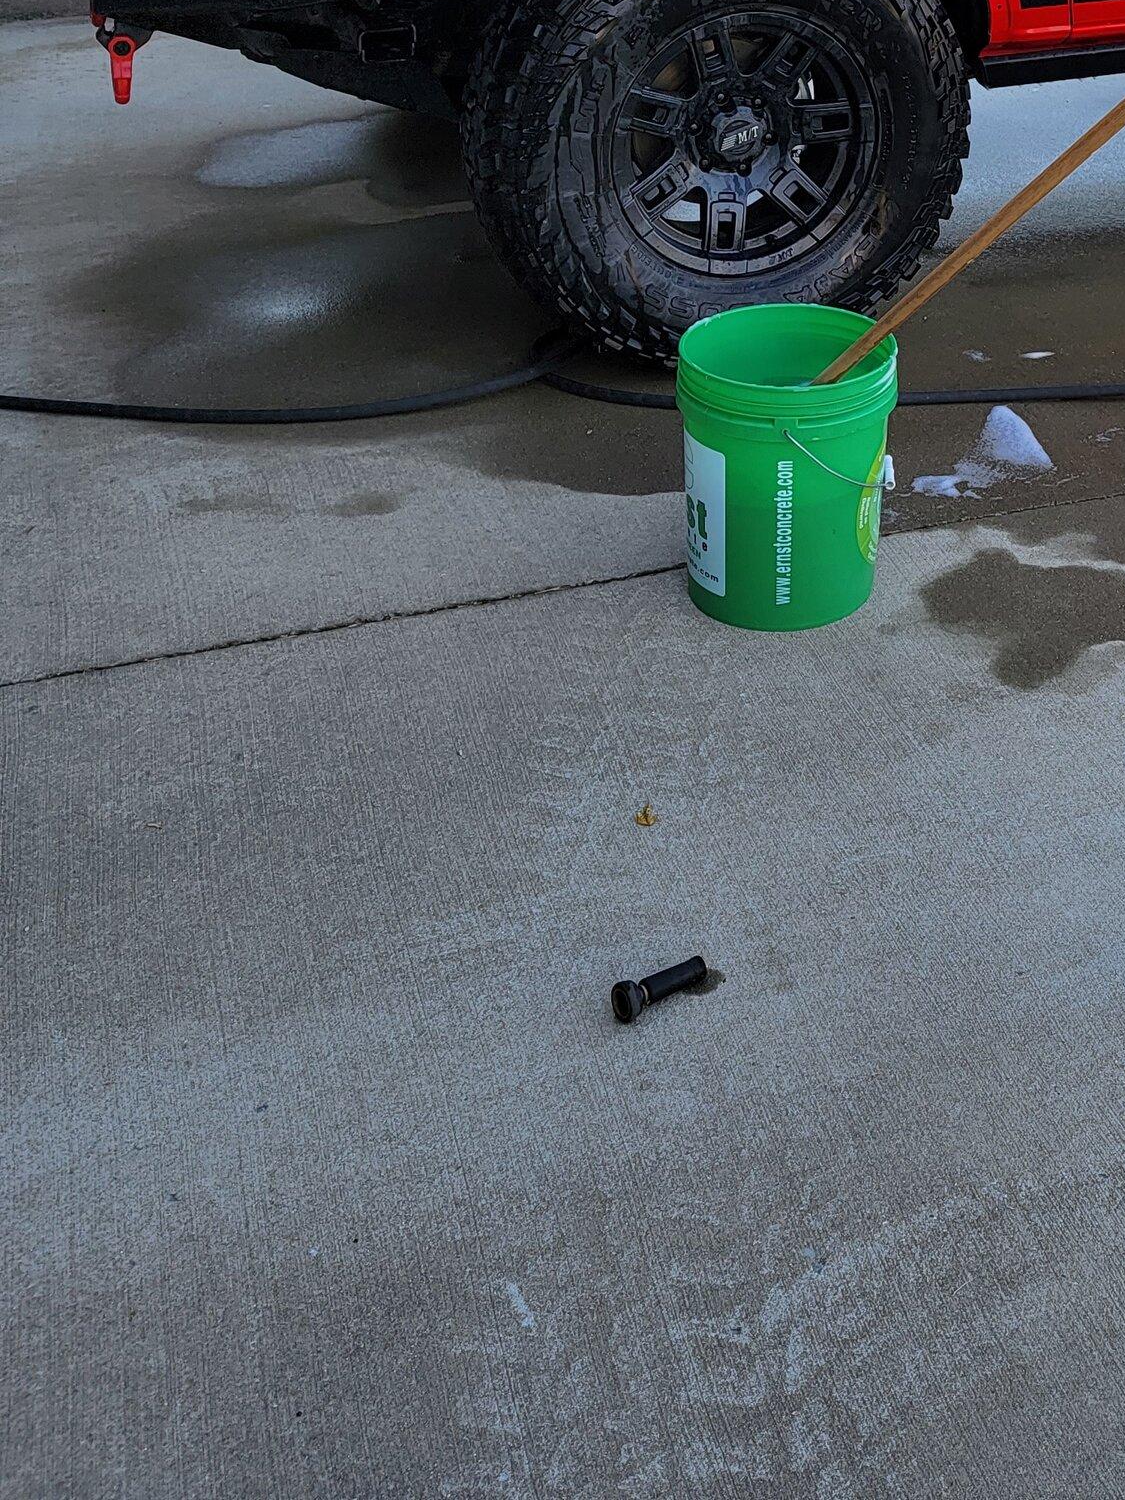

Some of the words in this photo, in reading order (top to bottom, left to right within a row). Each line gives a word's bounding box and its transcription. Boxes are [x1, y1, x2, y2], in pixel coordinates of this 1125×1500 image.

[737, 125, 759, 145] M/T
[644, 282, 755, 318] OSS
[774, 460, 794, 606] www.ernstconcrete.com
